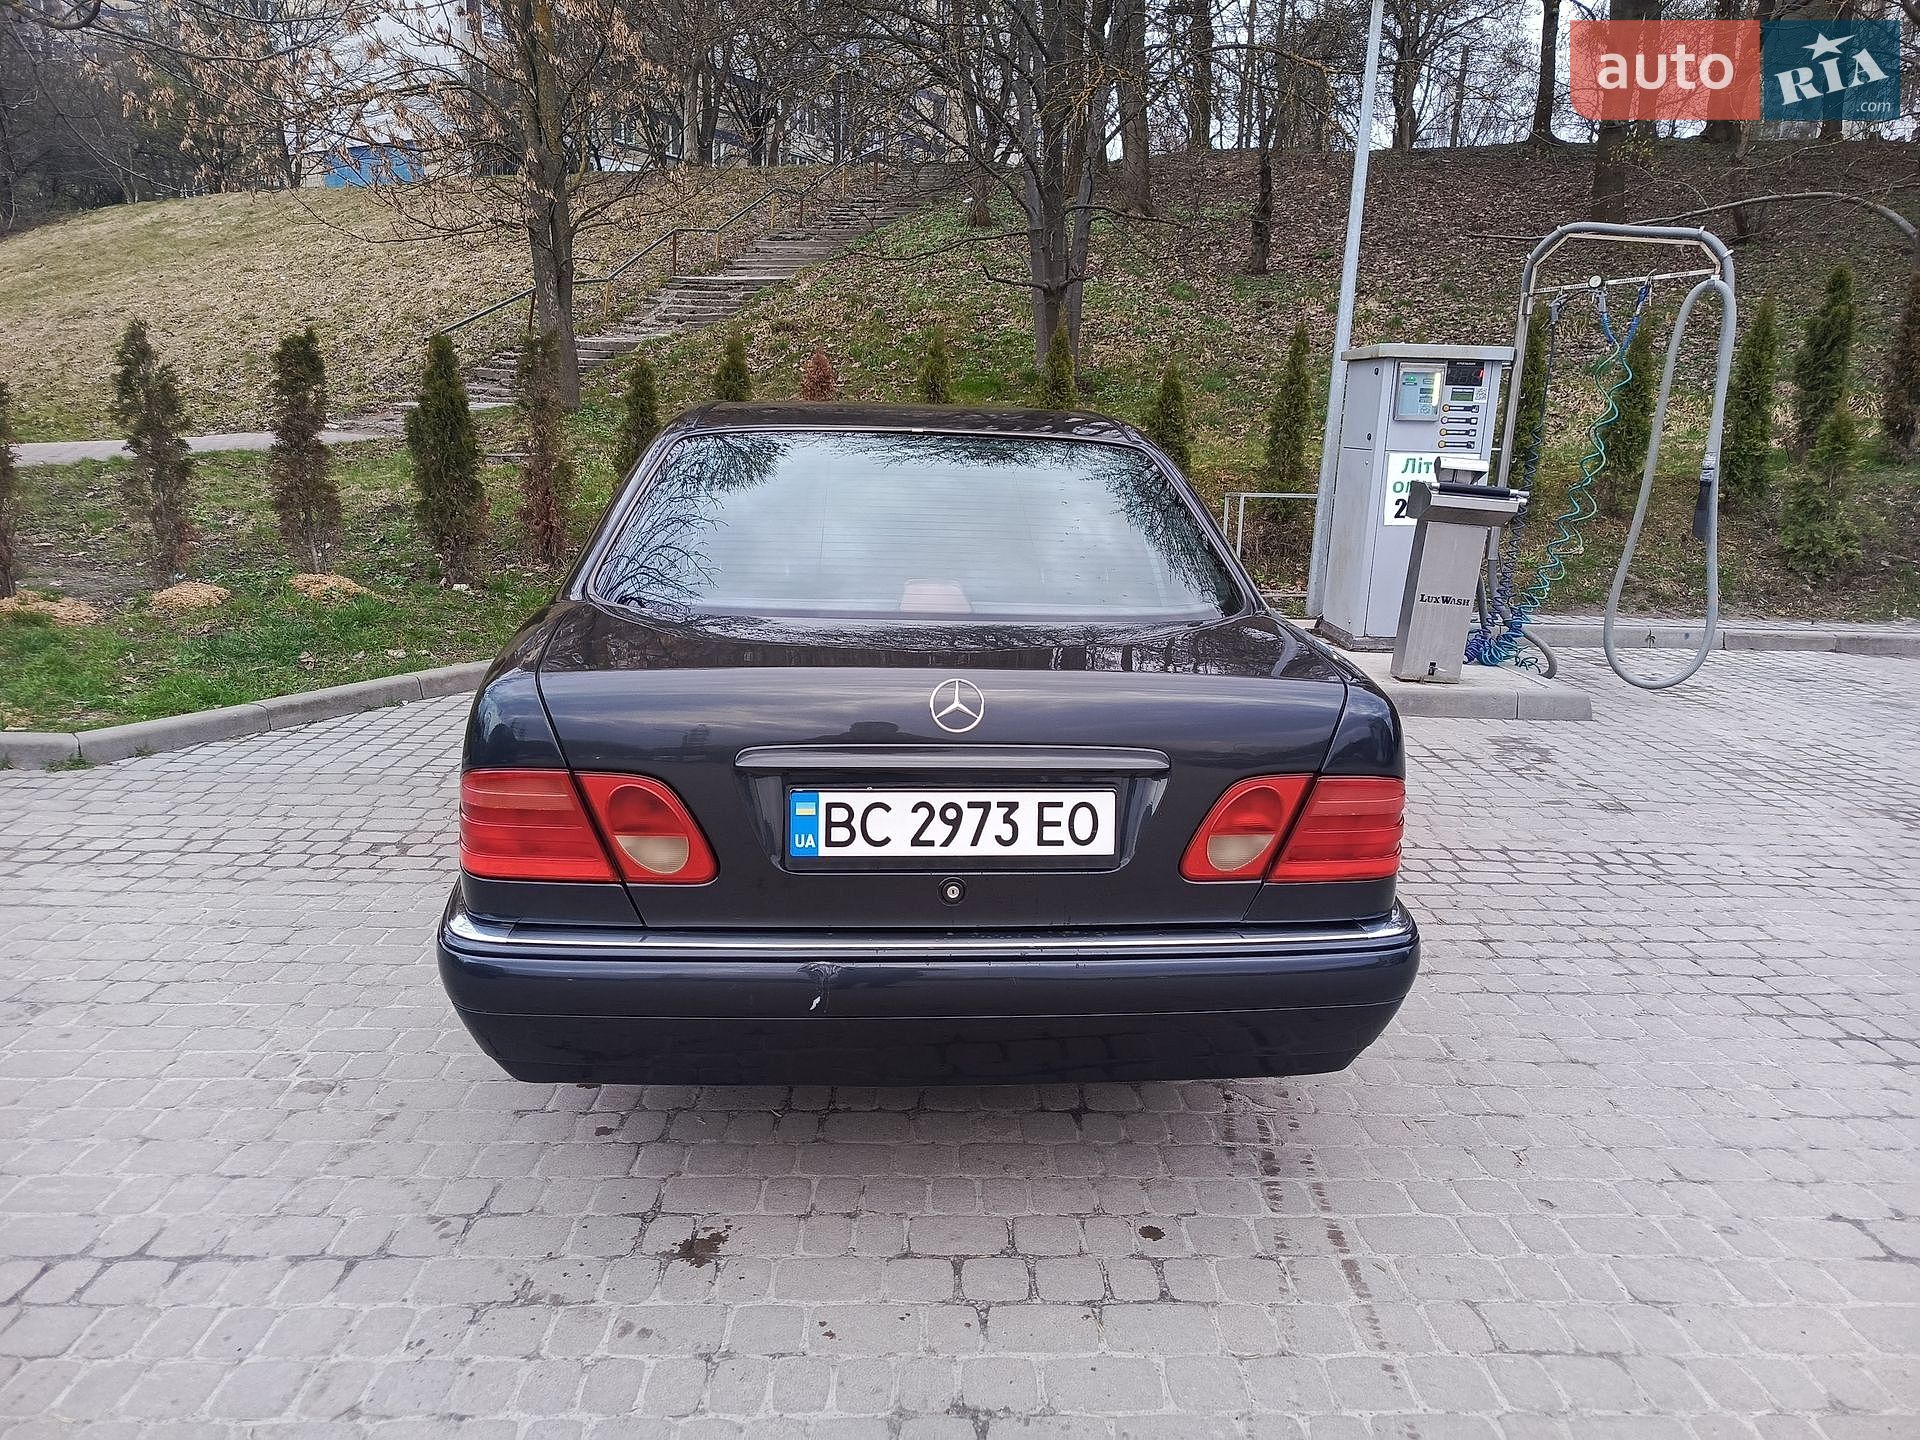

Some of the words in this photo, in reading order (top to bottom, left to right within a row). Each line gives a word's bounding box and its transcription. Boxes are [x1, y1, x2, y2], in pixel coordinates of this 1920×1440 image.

[824, 801, 892, 848] BC
[910, 801, 1019, 847] 2973
[1037, 801, 1099, 847] EO
[794, 833, 817, 848] UA
